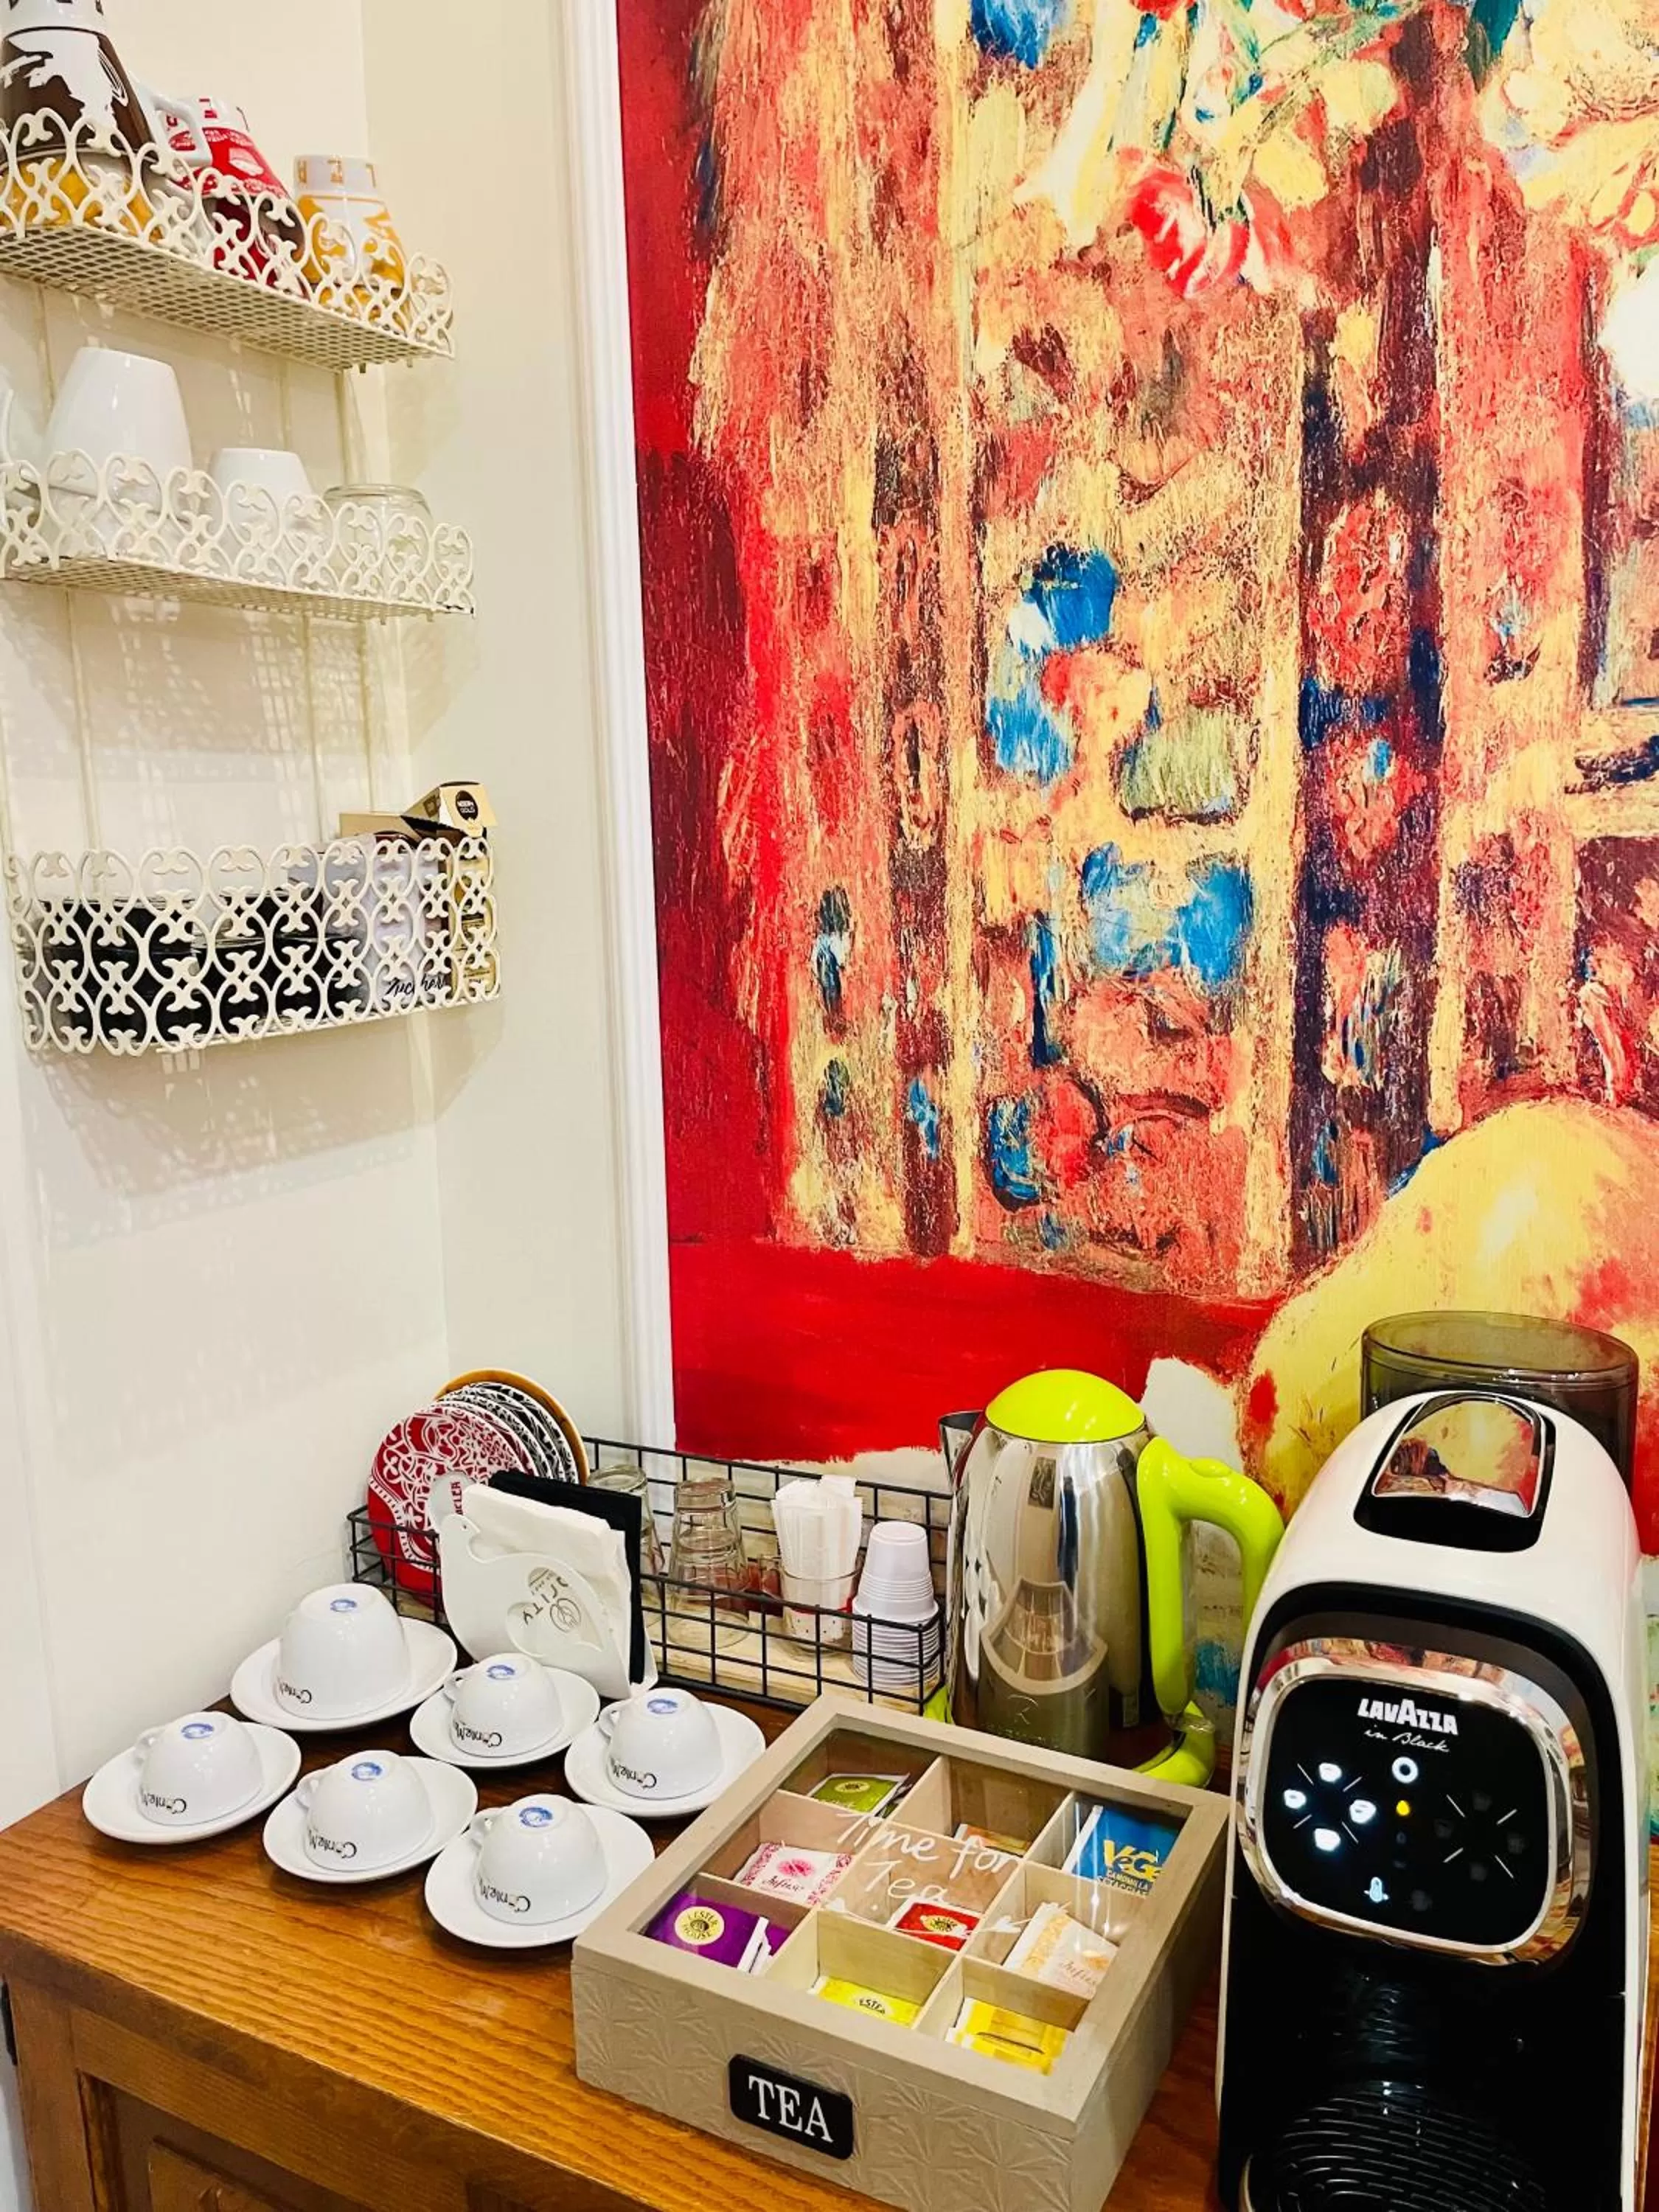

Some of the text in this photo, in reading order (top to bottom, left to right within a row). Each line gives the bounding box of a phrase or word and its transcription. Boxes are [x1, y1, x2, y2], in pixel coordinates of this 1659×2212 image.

[1357, 1698, 1458, 1736] LAVAZZA
[1364, 1725, 1450, 1753] in Black
[836, 1813, 1020, 1879] Time for
[864, 1860, 949, 1902] Tea
[748, 2074, 835, 2143] TEA
